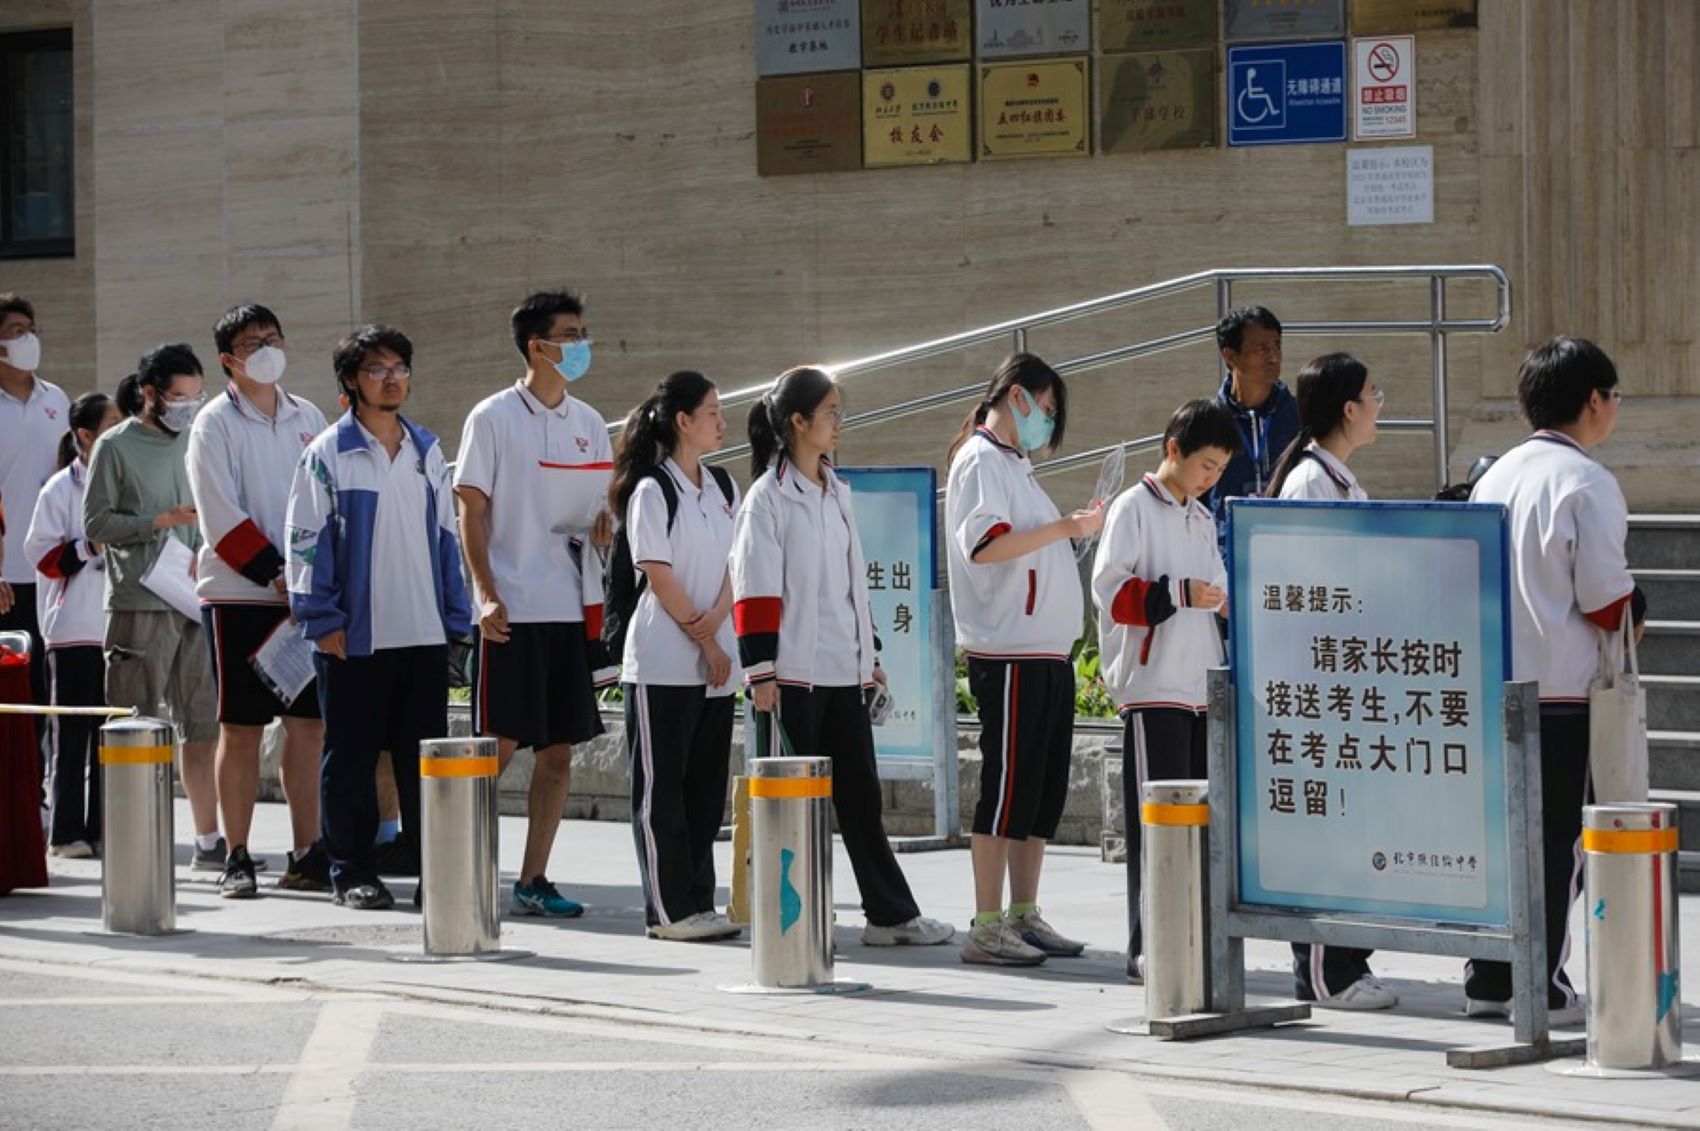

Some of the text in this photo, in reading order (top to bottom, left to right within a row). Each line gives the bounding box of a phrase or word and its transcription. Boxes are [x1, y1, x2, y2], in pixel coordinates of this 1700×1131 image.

[1287, 78, 1342, 96] 无障碍通道
[1362, 104, 1408, 115] NO SMOKING
[866, 561, 911, 591] 生出
[1262, 584, 1364, 614] 温馨提示：
[1311, 635, 1463, 678] 请家长按时
[1266, 680, 1470, 728] 接送考生，不要
[1267, 729, 1468, 775] 在考点大门口
[1268, 777, 1346, 817] 逗留！
